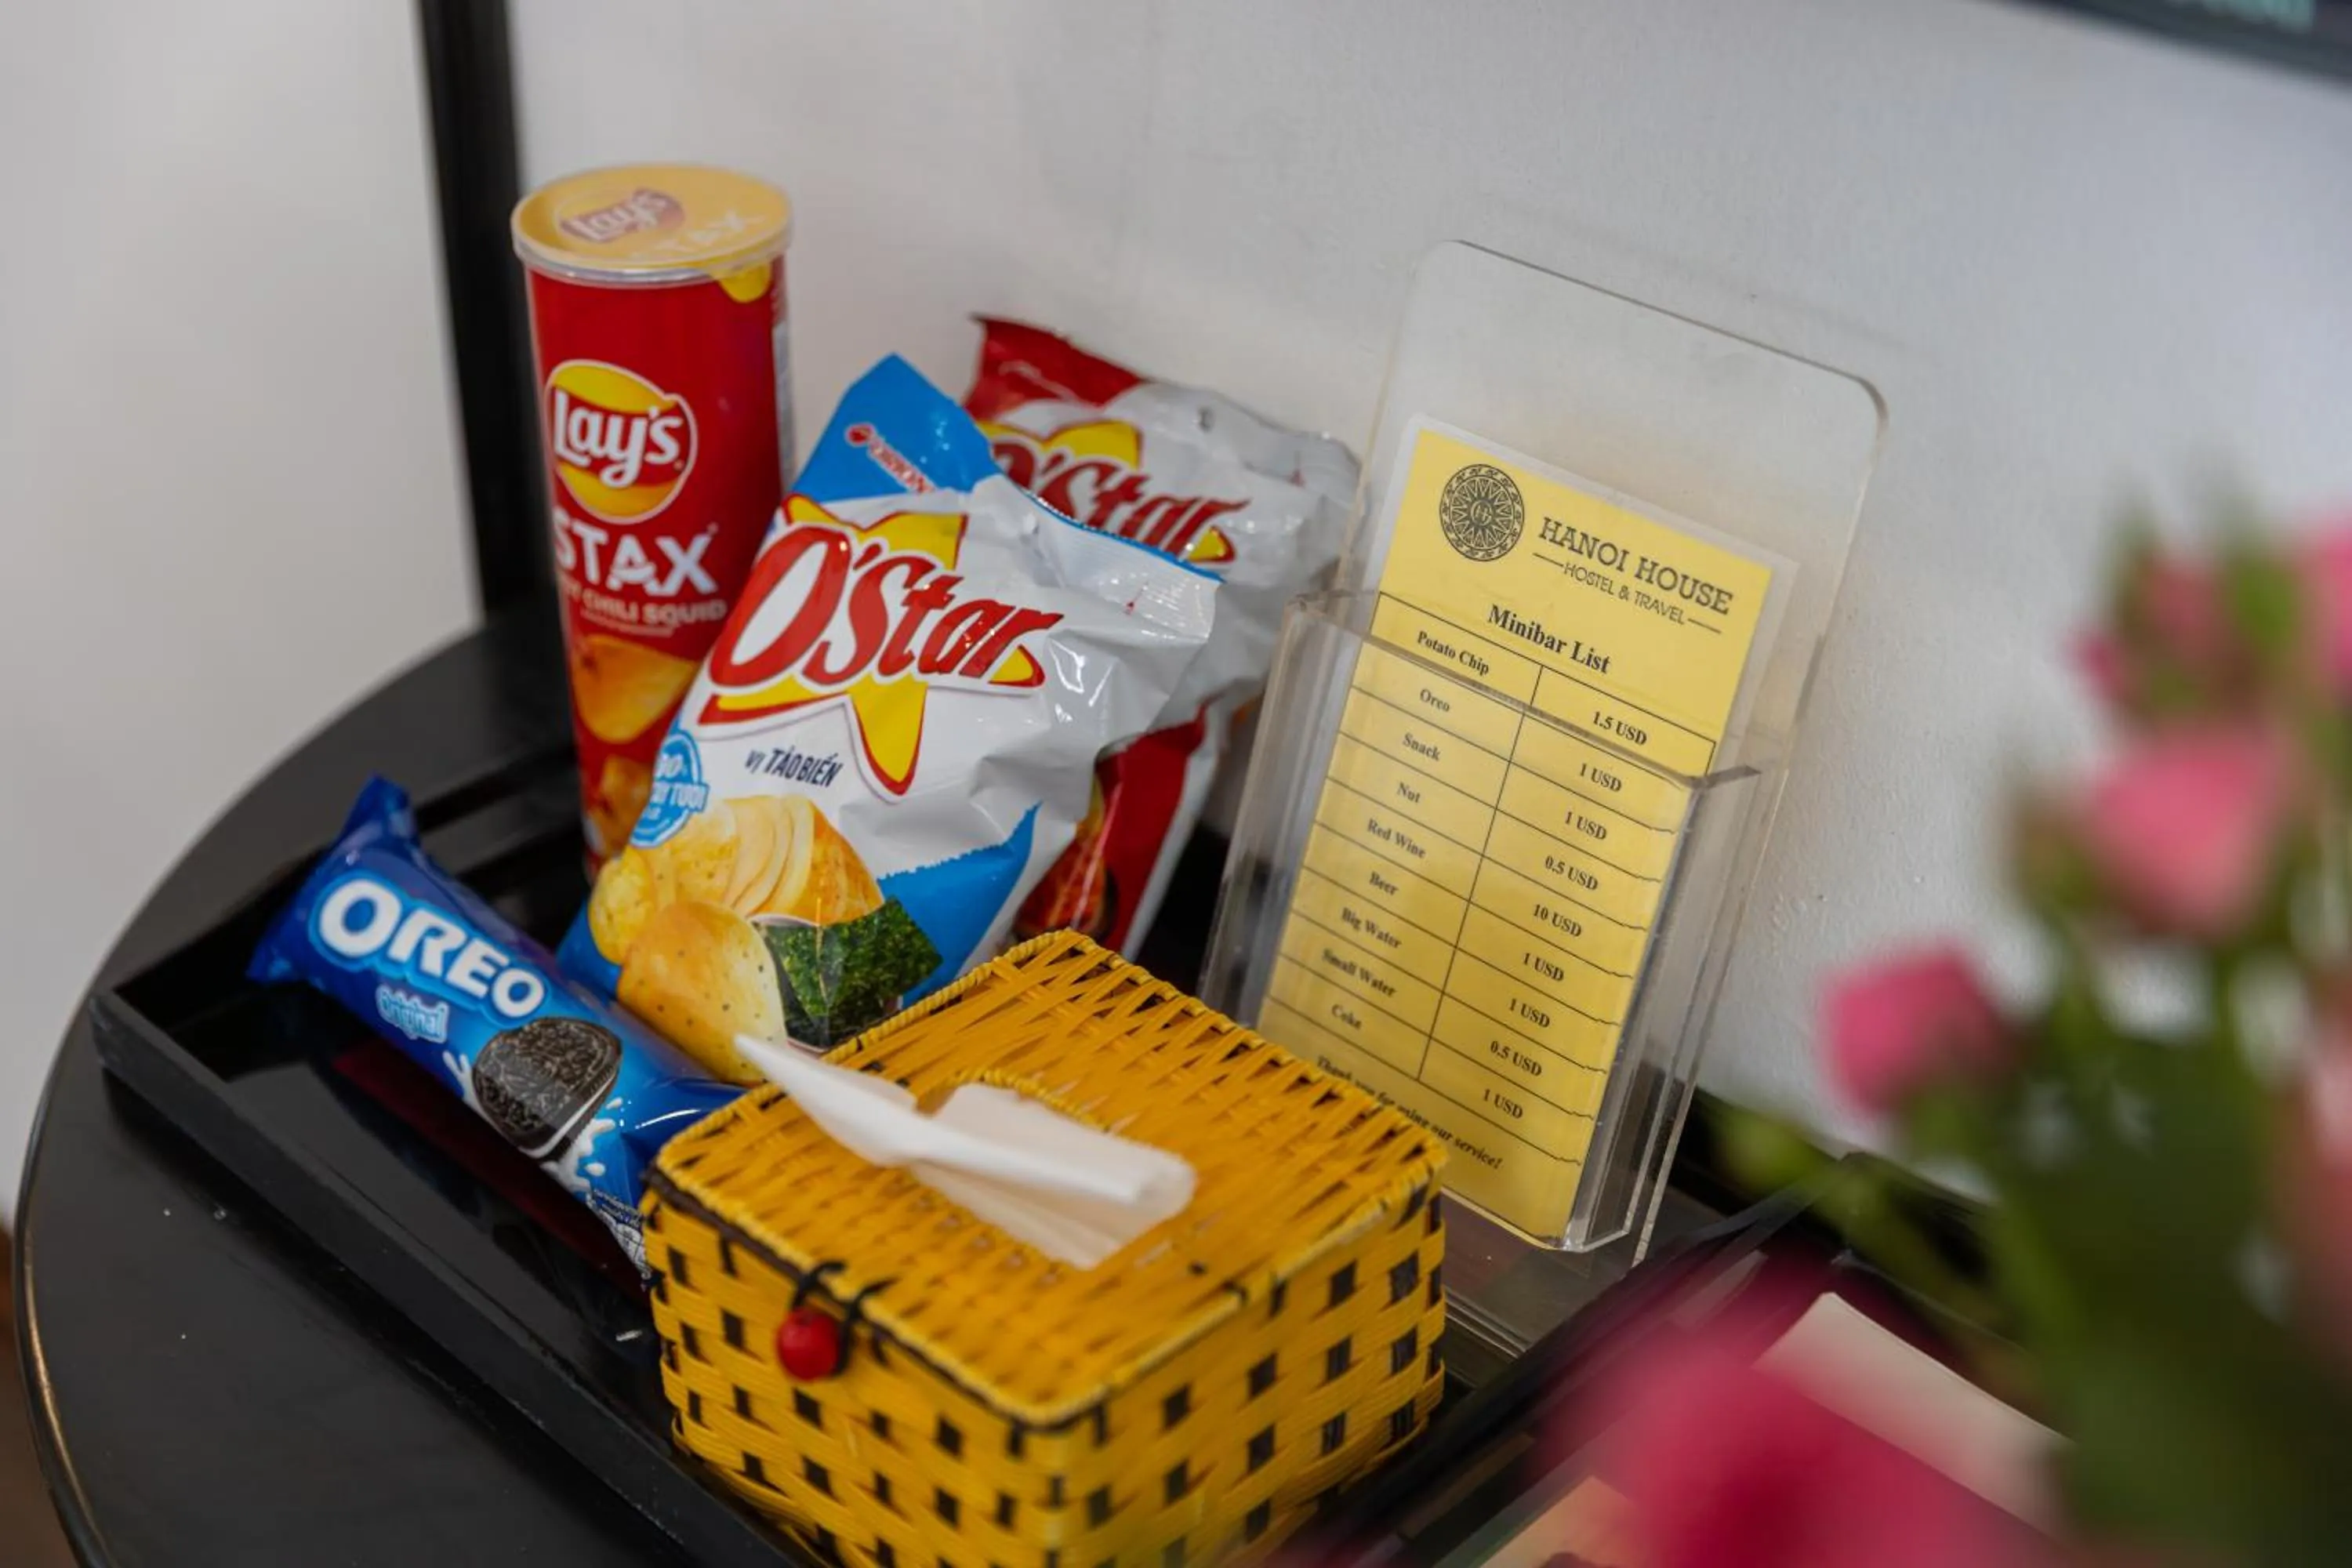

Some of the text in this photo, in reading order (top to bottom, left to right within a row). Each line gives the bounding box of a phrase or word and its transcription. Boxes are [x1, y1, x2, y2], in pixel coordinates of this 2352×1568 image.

[554, 389, 683, 488] Lay's
[553, 506, 717, 597] STAX
[1538, 517, 1733, 615] HANOI HOUSE
[710, 526, 1064, 688] O'Star
[1563, 562, 1685, 625] HOSTEL & TRAVEL
[1417, 630, 1490, 676] Potato Chip
[1487, 604, 1610, 674] Minibar List
[1420, 688, 1450, 713] Oreo
[1403, 731, 1441, 762] Snack
[1592, 711, 1648, 747] 1.5 USD
[1396, 782, 1421, 804] Nut
[1580, 763, 1622, 793] 1 USD
[1367, 818, 1425, 859] Red Wine
[1565, 811, 1607, 841] 1 USD
[1369, 871, 1399, 895] Beer
[1544, 855, 1599, 891] 0.5 USD
[1341, 906, 1402, 949] Big Water
[1533, 903, 1582, 938] 10 USD
[318, 879, 545, 1018] OREO
[1322, 949, 1396, 998] Small Water
[1532, 956, 1564, 982] USD
[1332, 1004, 1362, 1030] Coke
[1508, 998, 1550, 1029] 1 USD
[1489, 1040, 1542, 1077] 0.5 USD
[1483, 1088, 1524, 1120] 1 USD
[1431, 1126, 1453, 1141] our
[1454, 1136, 1503, 1169] service!
